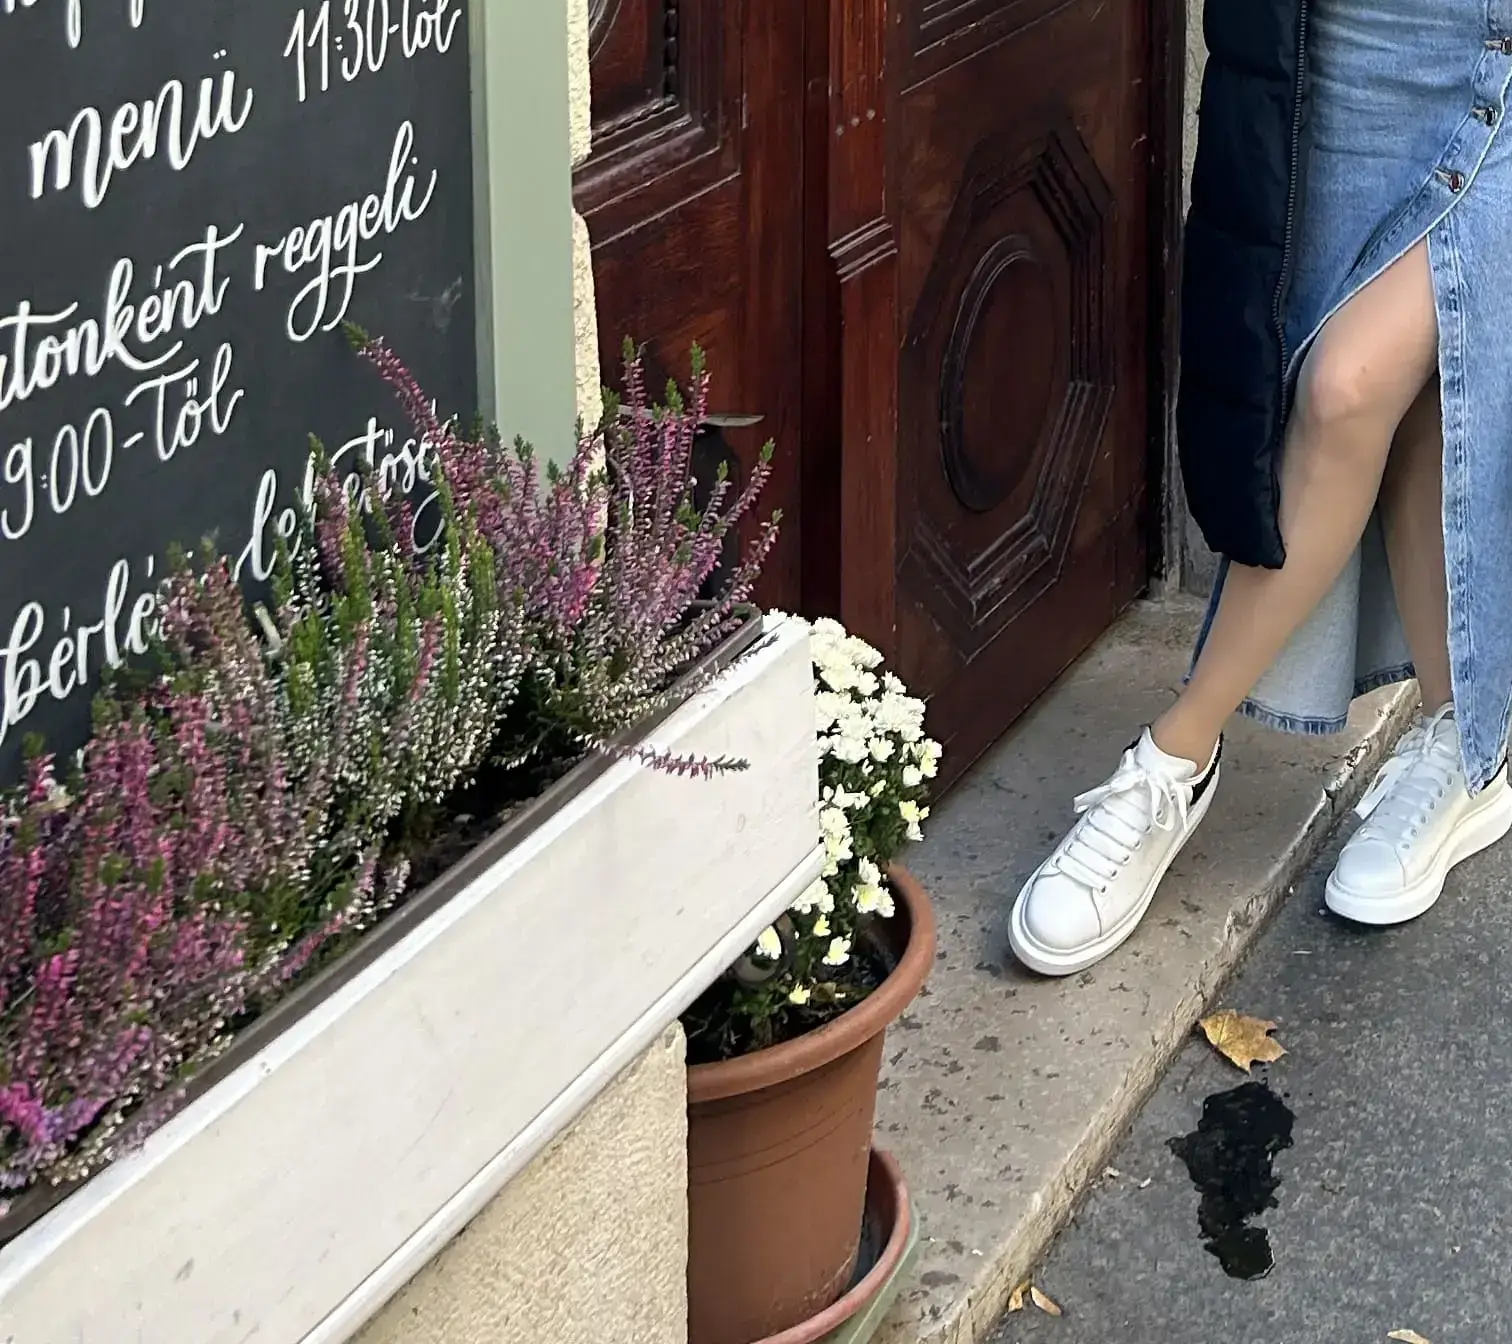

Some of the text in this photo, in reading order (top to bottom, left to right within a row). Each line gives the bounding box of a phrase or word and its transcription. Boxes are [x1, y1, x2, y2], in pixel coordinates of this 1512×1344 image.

[29, 48, 253, 208] menü
[254, 120, 437, 342] reggeli
[0, 555, 170, 746] bérlé
